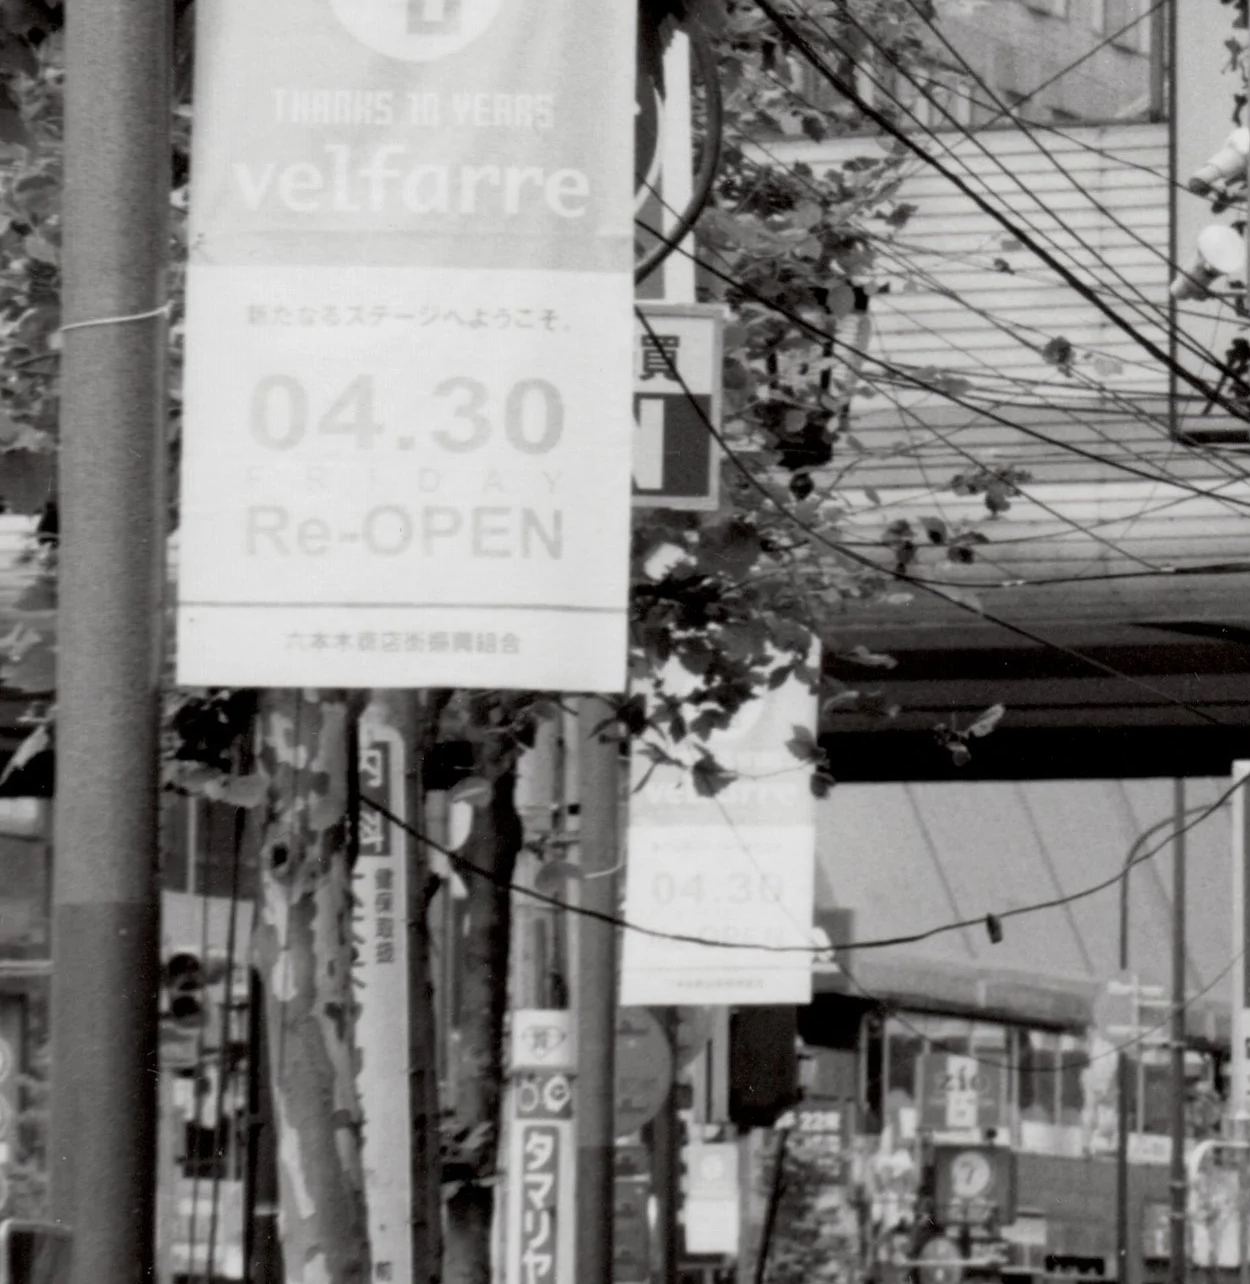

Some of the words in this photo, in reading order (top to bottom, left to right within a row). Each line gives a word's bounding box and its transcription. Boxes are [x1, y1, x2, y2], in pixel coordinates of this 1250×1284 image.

[232, 142, 590, 218] velfarre
[247, 372, 565, 455] 04.30
[244, 503, 564, 560] Re-OPEN
